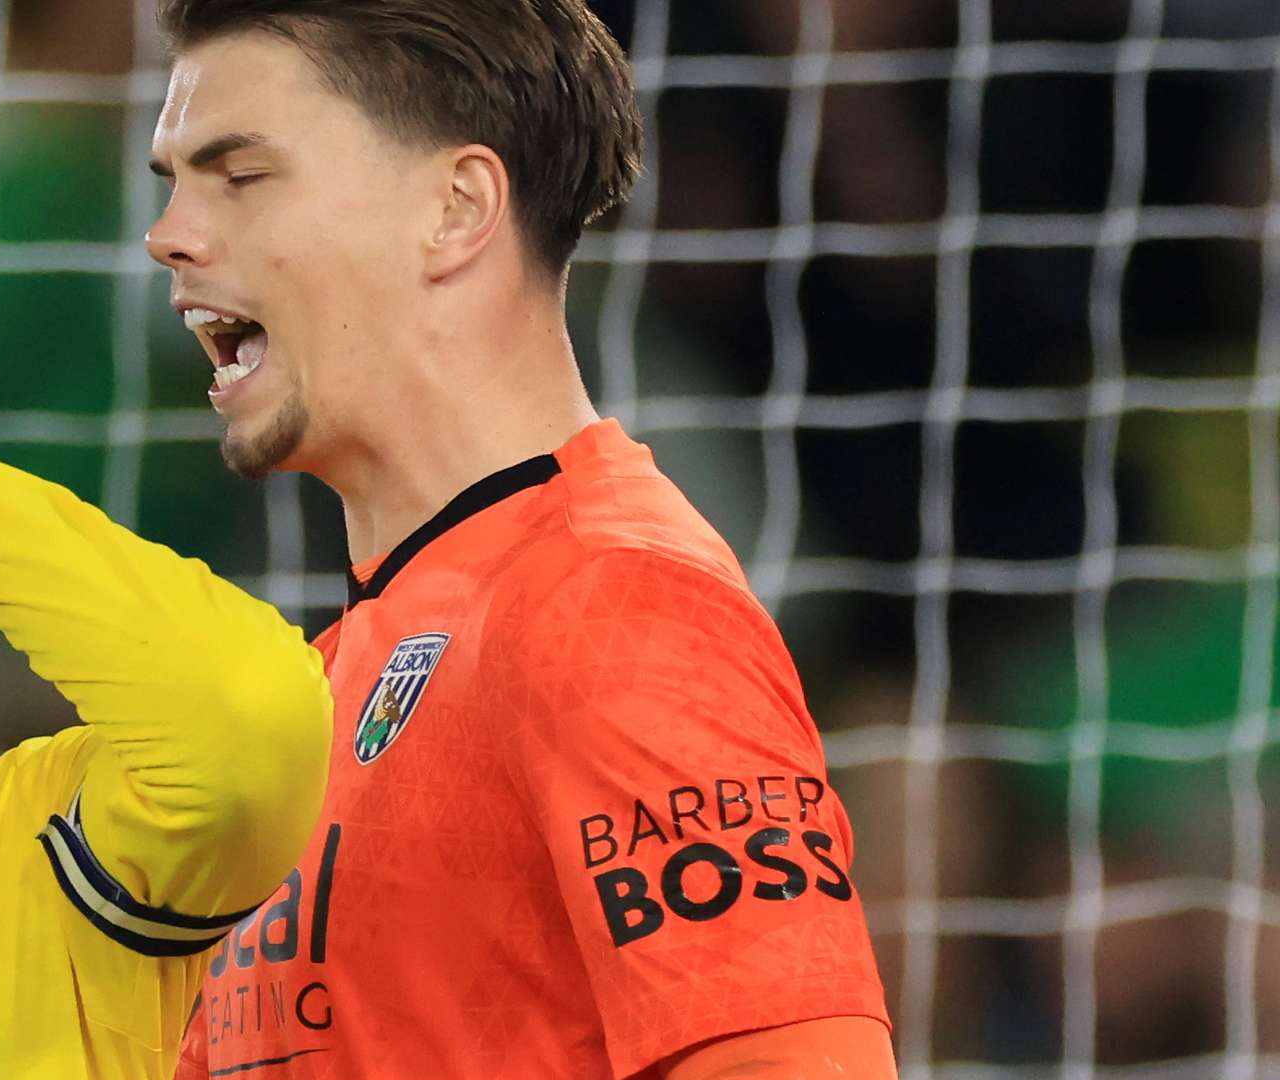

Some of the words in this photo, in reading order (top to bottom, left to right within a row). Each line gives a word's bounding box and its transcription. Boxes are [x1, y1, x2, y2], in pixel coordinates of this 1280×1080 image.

[579, 776, 824, 869] BARBER
[593, 827, 852, 948] BOSS
[211, 980, 332, 1044] EATING
